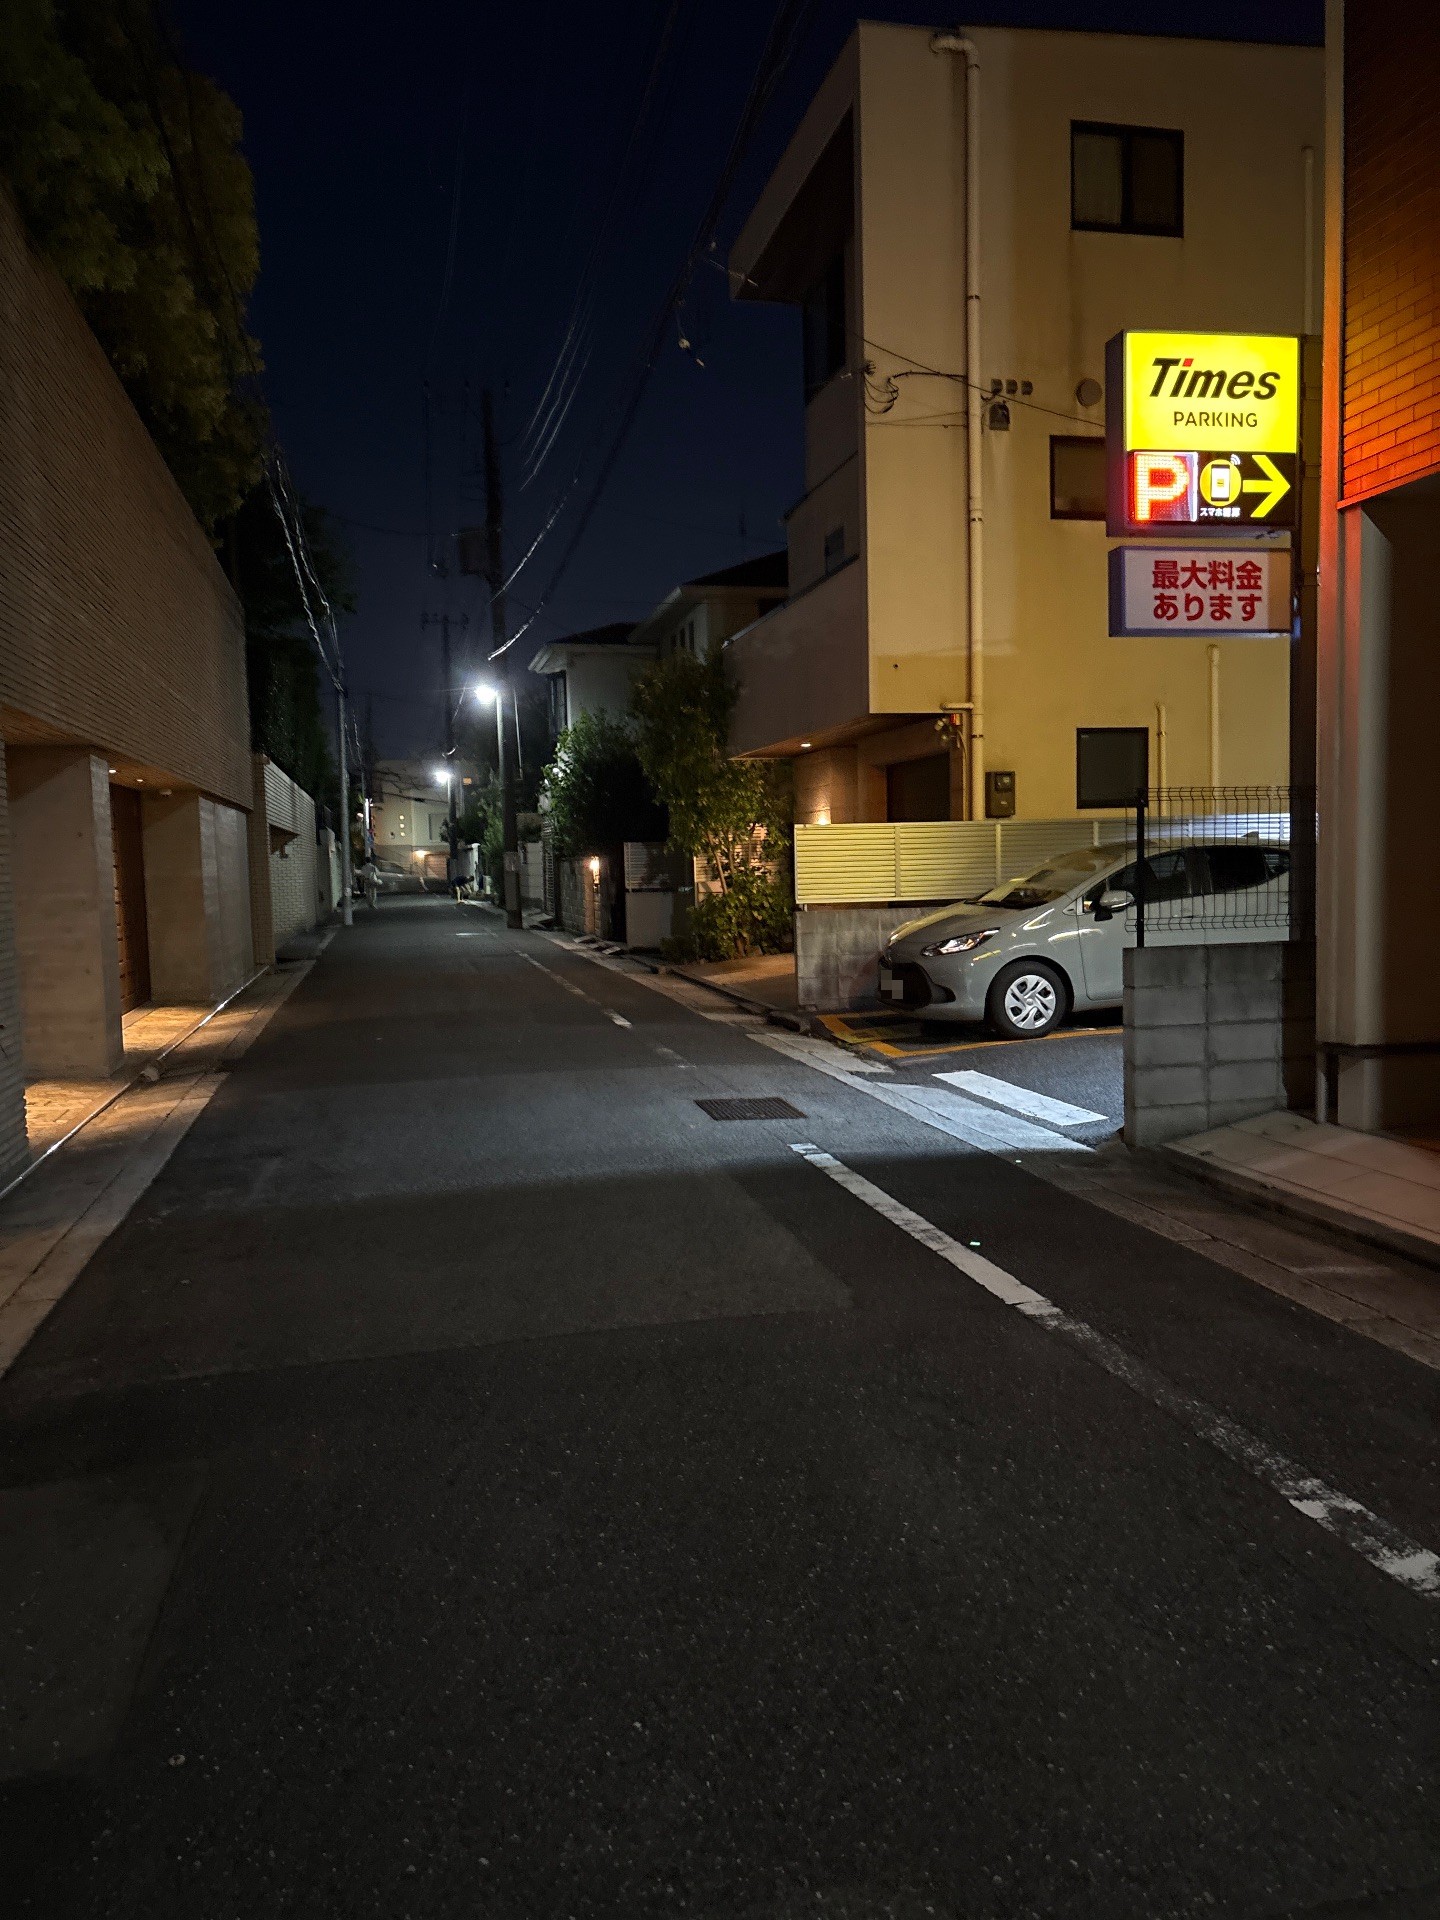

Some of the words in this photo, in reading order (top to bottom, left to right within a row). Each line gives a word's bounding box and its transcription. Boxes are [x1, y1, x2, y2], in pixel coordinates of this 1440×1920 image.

[1149, 357, 1281, 400] Times
[1173, 411, 1258, 428] PARKING
[1136, 455, 1189, 520] P
[1152, 560, 1262, 590] 最大料金
[1153, 593, 1262, 622] あります
